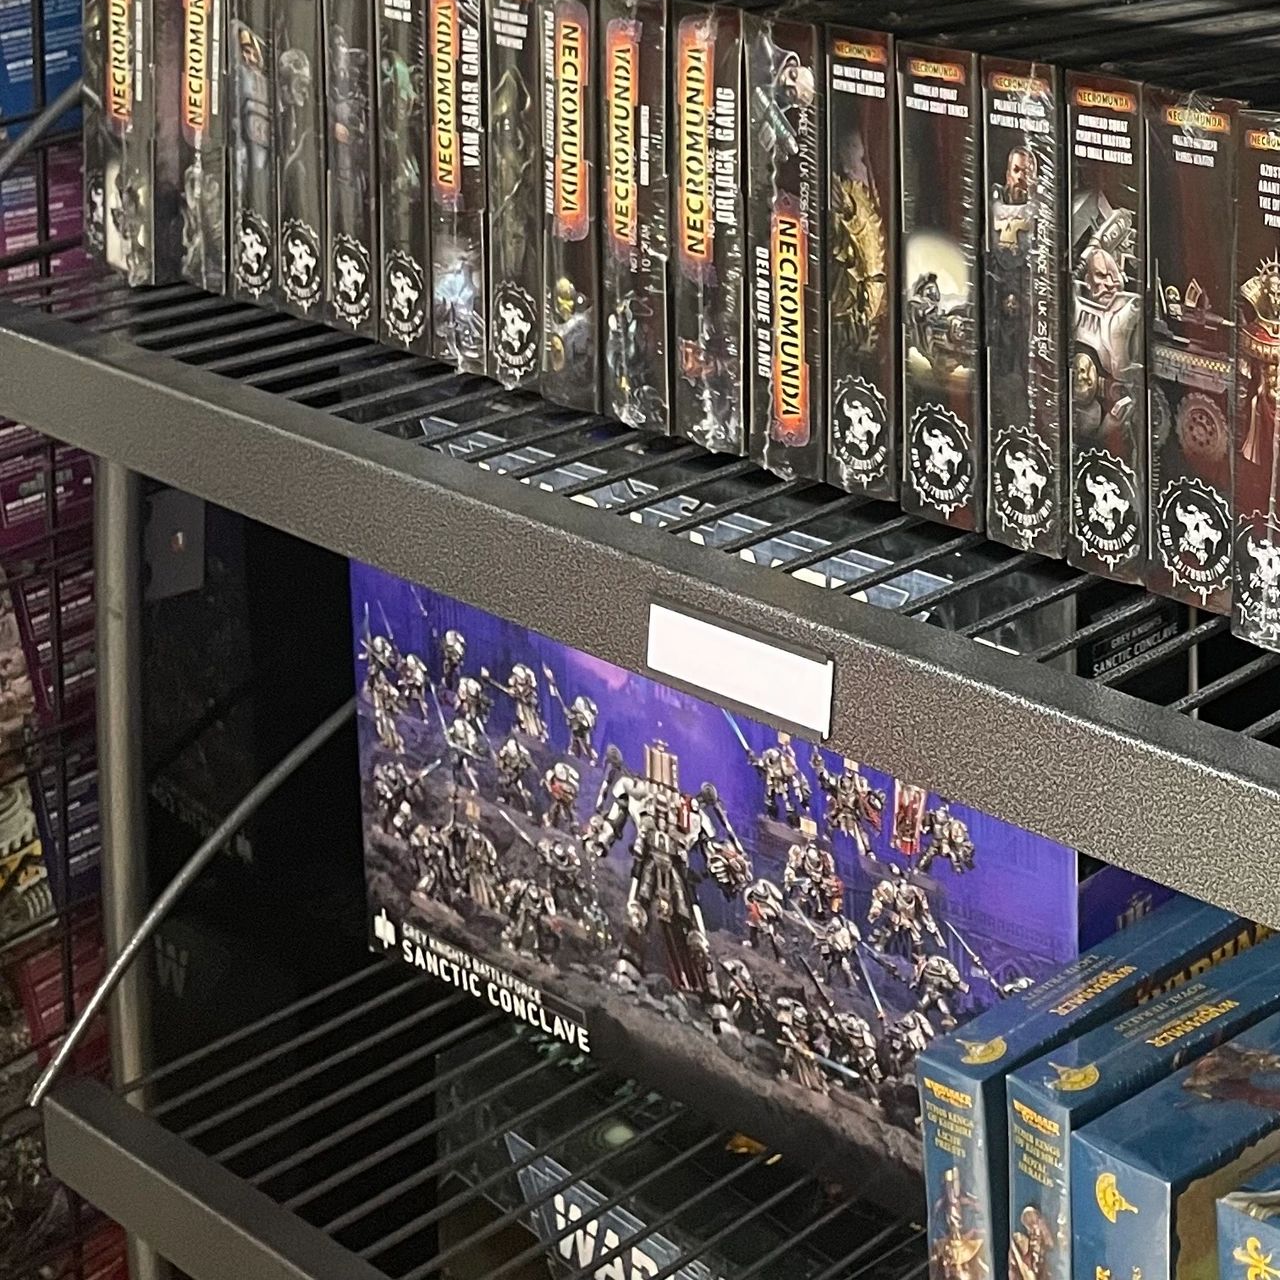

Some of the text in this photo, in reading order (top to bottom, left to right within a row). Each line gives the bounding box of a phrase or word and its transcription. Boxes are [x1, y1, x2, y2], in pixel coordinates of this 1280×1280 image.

[433, 2, 454, 185] NECROMUNDA
[466, 24, 482, 74] GANG
[912, 62, 959, 79] NECROMUNDA
[1078, 91, 1130, 110] NECROMUNDA
[560, 23, 582, 215] NECROMUNDA
[614, 45, 632, 238] NECROMUNDA
[686, 46, 706, 256] NECROMUNDA
[714, 85, 736, 227] ORLOCK GANG
[755, 245, 771, 377] DELAQUE GANG
[776, 218, 803, 421] NECROMUNDA
[1093, 623, 1179, 676] SANCTIC CONCLAVE
[402, 940, 591, 1053] SANCTIC CONCLAVE
